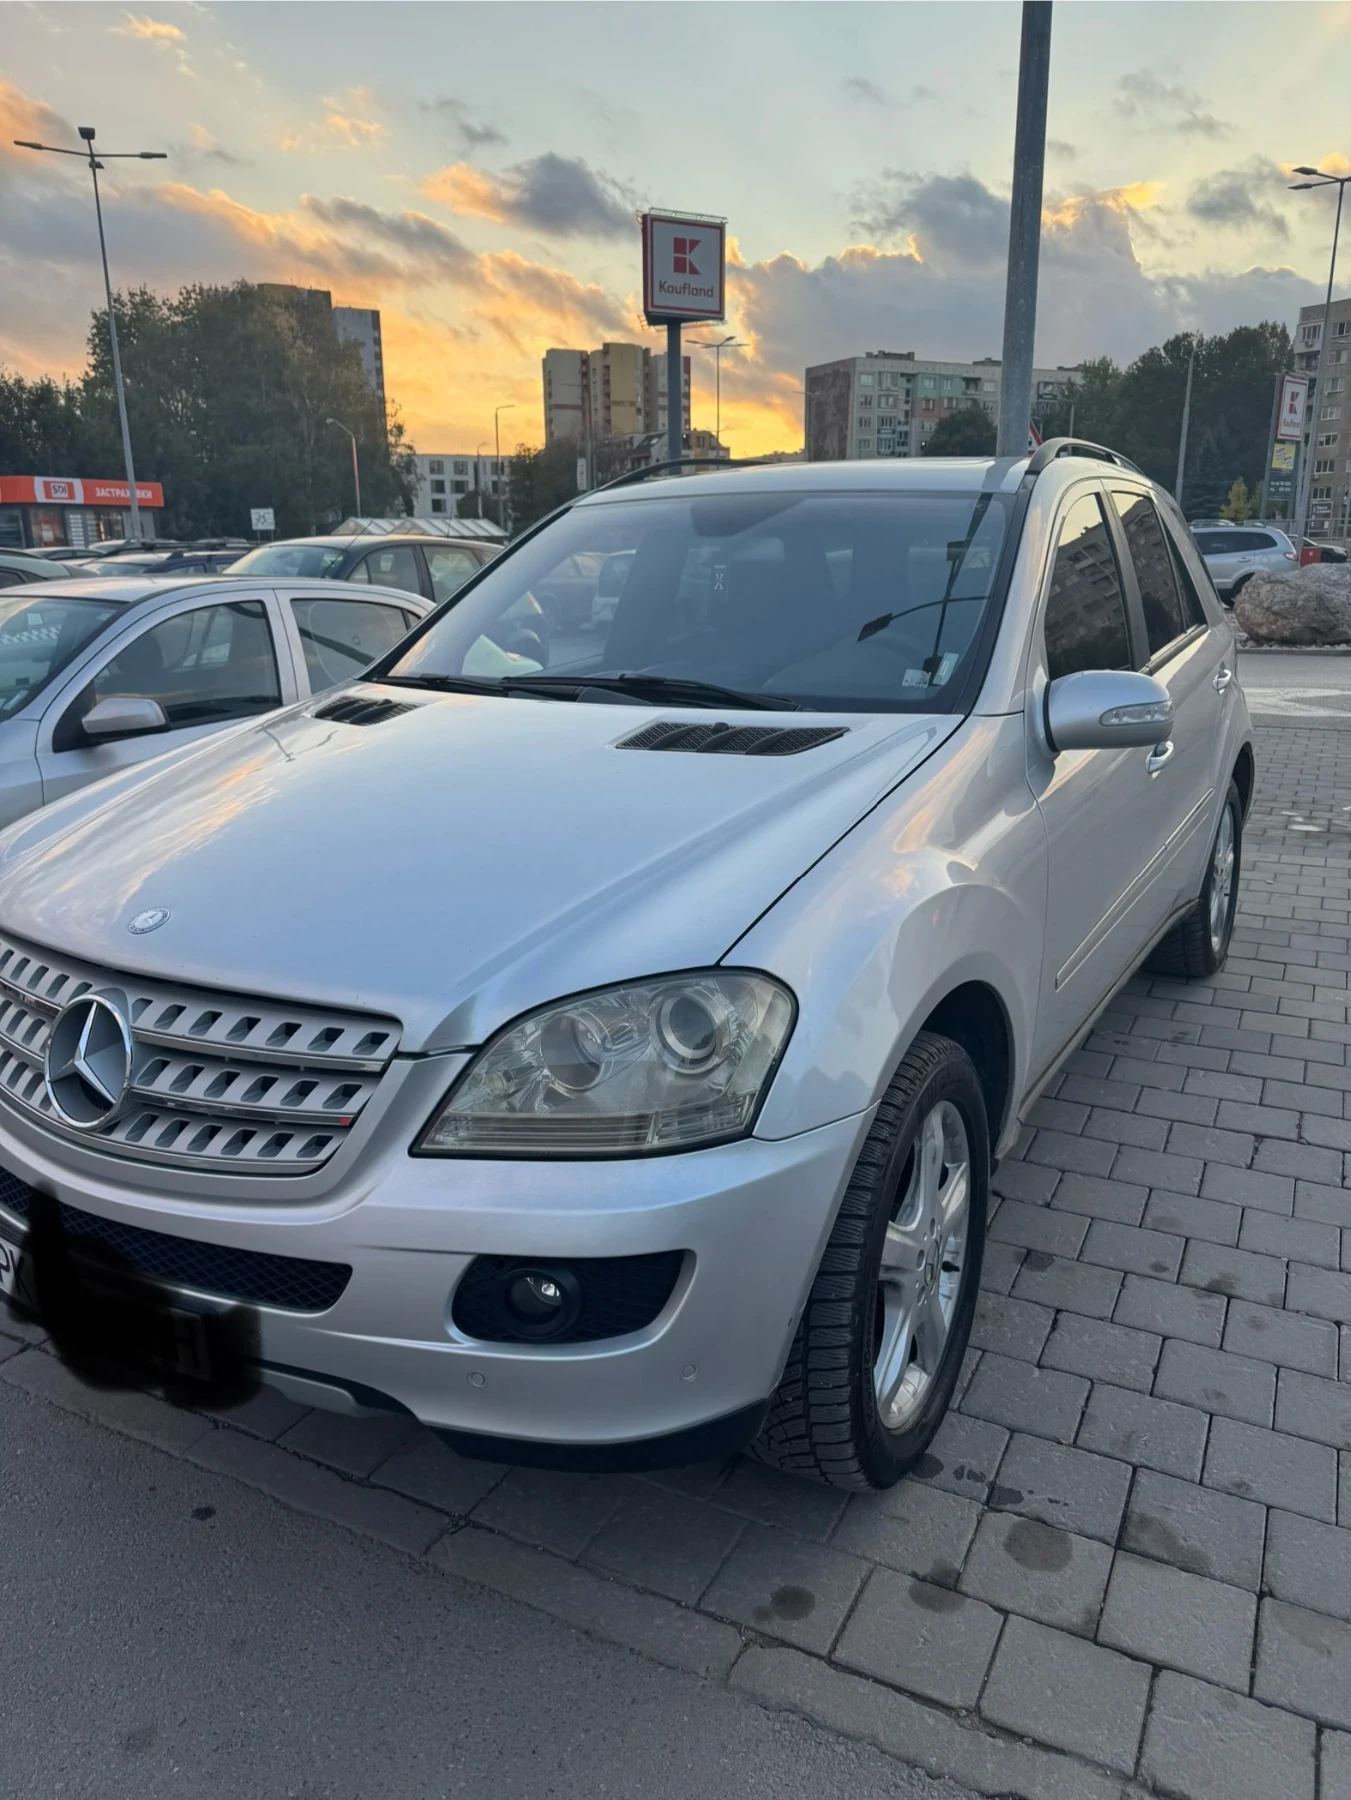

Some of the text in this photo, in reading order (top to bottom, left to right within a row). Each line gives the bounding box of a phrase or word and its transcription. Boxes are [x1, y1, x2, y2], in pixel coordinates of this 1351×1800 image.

[673, 236, 702, 275] K
[658, 280, 714, 298] Kaufland
[95, 487, 153, 499] ЗАСТРАХВКИ
